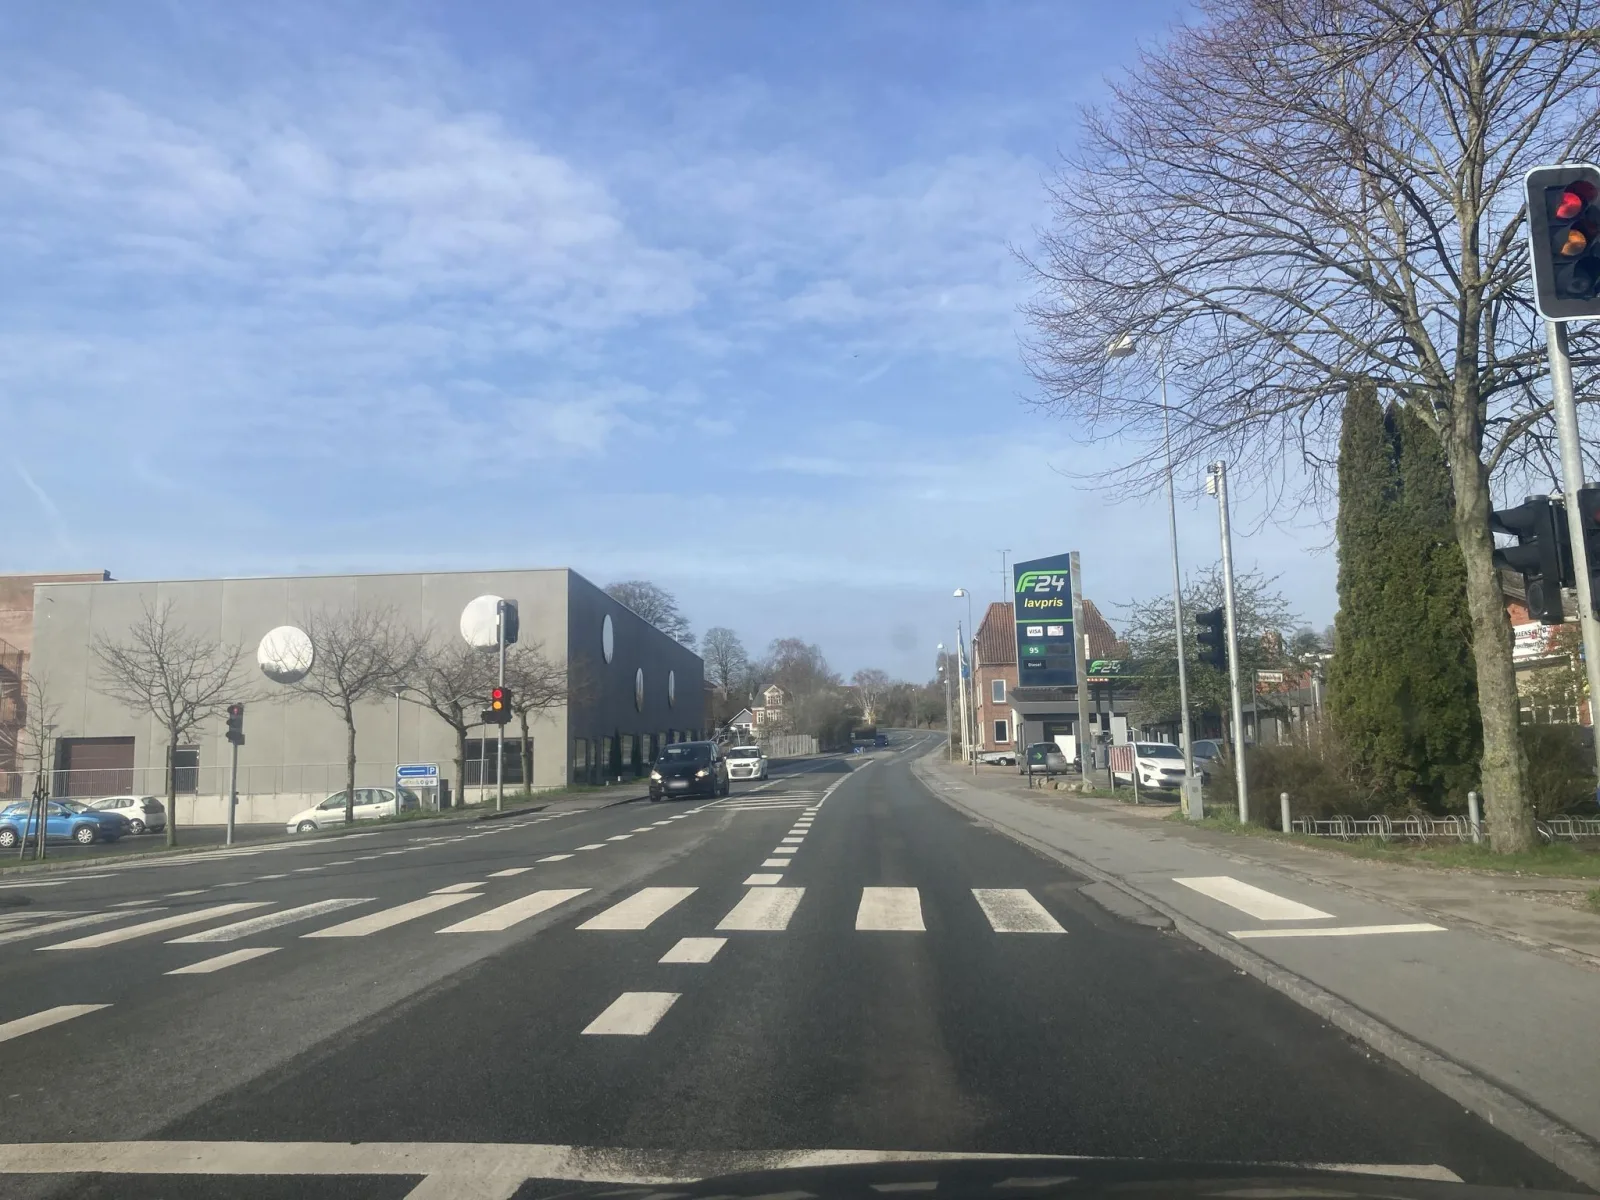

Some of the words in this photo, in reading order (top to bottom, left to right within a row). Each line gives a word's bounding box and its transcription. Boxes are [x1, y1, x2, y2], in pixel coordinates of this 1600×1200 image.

[1016, 570, 1068, 592] F24
[1024, 597, 1063, 609] lavpris
[1089, 660, 1121, 673] F24
